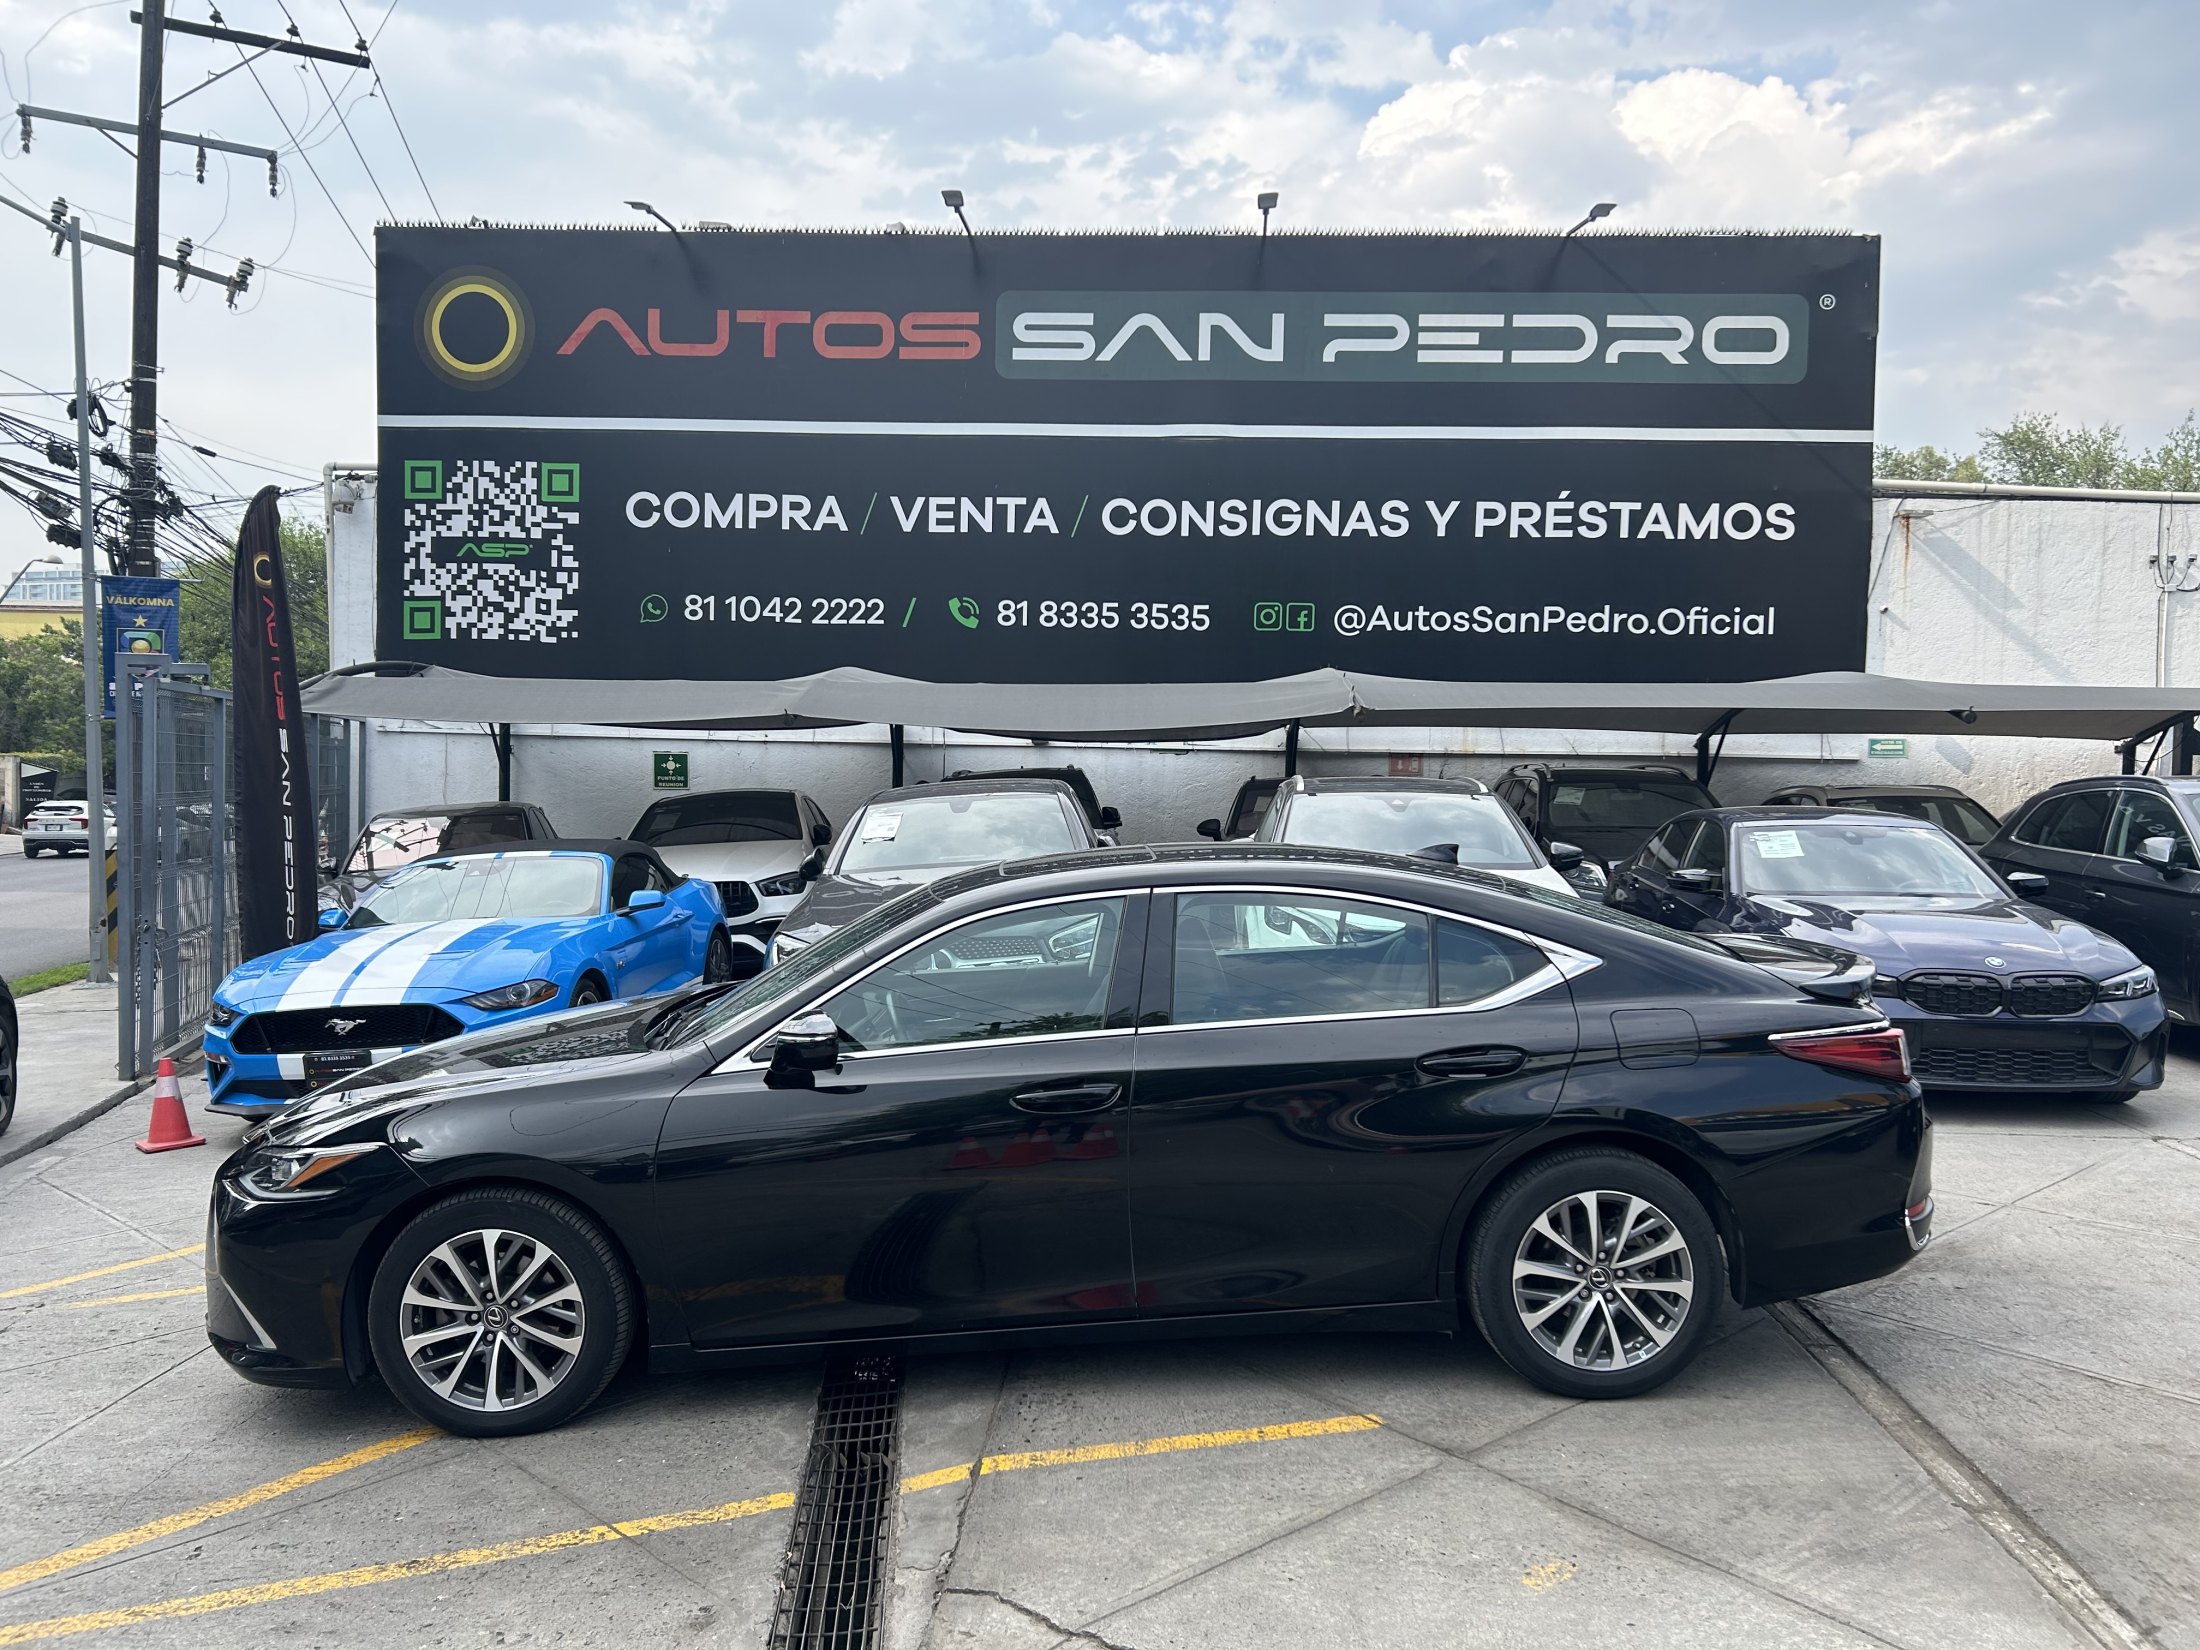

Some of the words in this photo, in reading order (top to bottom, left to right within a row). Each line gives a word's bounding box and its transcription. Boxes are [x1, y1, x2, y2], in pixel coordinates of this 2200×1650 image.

[556, 308, 980, 360] AUTOS
[1011, 311, 1285, 362] SAN
[1322, 312, 1790, 365] PEDRO
[625, 491, 849, 532] COMPRA
[889, 495, 1060, 534] VENTA
[1101, 498, 1410, 538] CONSIGNAS
[1424, 500, 1461, 537] Y
[1474, 491, 1796, 541] PRÉSTAMOS
[456, 543, 530, 557] ASP
[106, 595, 175, 607] VÄLKOMNA
[684, 594, 715, 621] 81
[725, 595, 802, 624] 1042
[811, 597, 885, 625] 2222
[997, 599, 1028, 627] 81
[1039, 600, 1120, 629] 8335
[1130, 602, 1210, 631] 3535
[1333, 604, 1775, 637] @AutosSanPedro.Oficial
[279, 728, 291, 807] SAN
[283, 815, 295, 940] PEDRO
